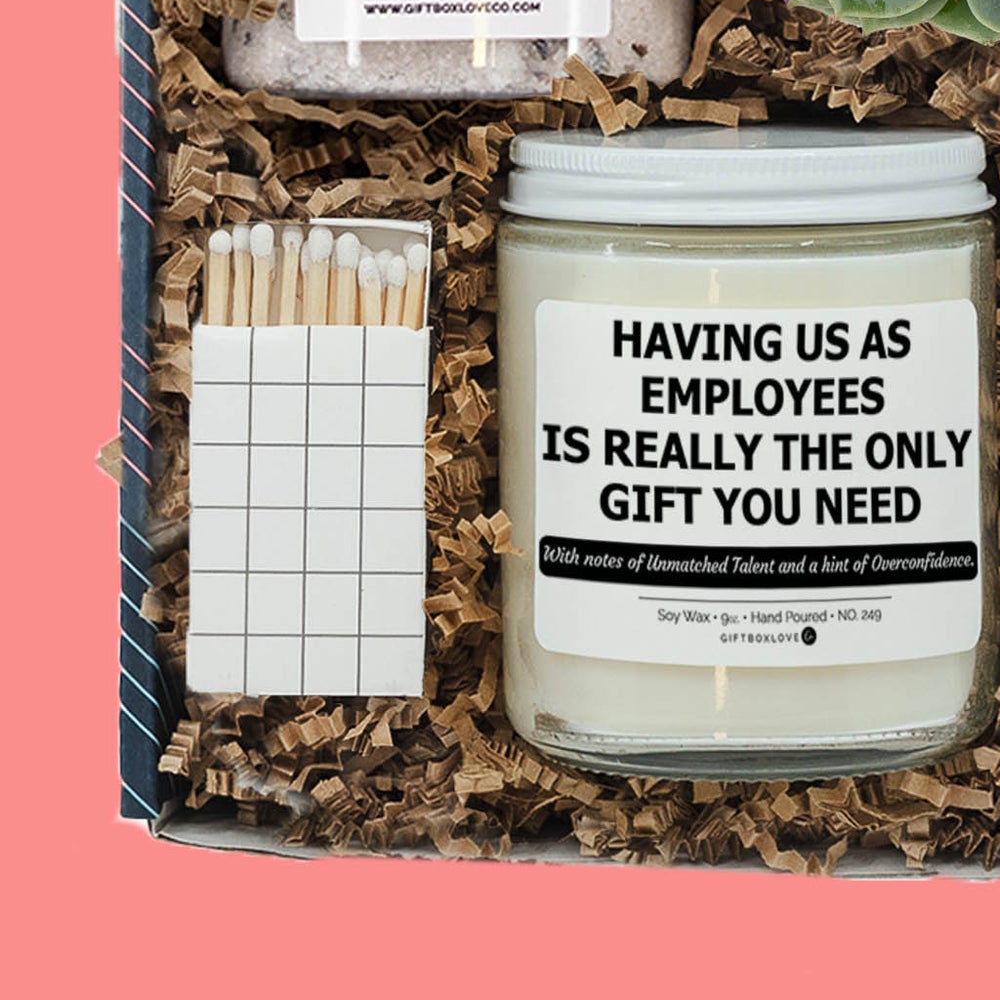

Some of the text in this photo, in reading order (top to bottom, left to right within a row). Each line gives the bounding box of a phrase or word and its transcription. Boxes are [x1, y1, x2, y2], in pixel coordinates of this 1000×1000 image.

[612, 319, 911, 361] HAVING US AS
[641, 376, 885, 416] EMPLOYEES
[542, 424, 972, 471] IS REALLY THE ONLY
[599, 483, 921, 526] GIFT YOU NEED
[542, 544, 975, 575] With notes of Unmatched Talent and a hint of Overconfidence.
[657, 608, 680, 625] Soy
[683, 609, 711, 623] Wax
[750, 610, 782, 624] Hand
[785, 609, 827, 624] Poured
[861, 608, 882, 622] 249
[720, 632, 800, 644] GIFTBOXLOVE
